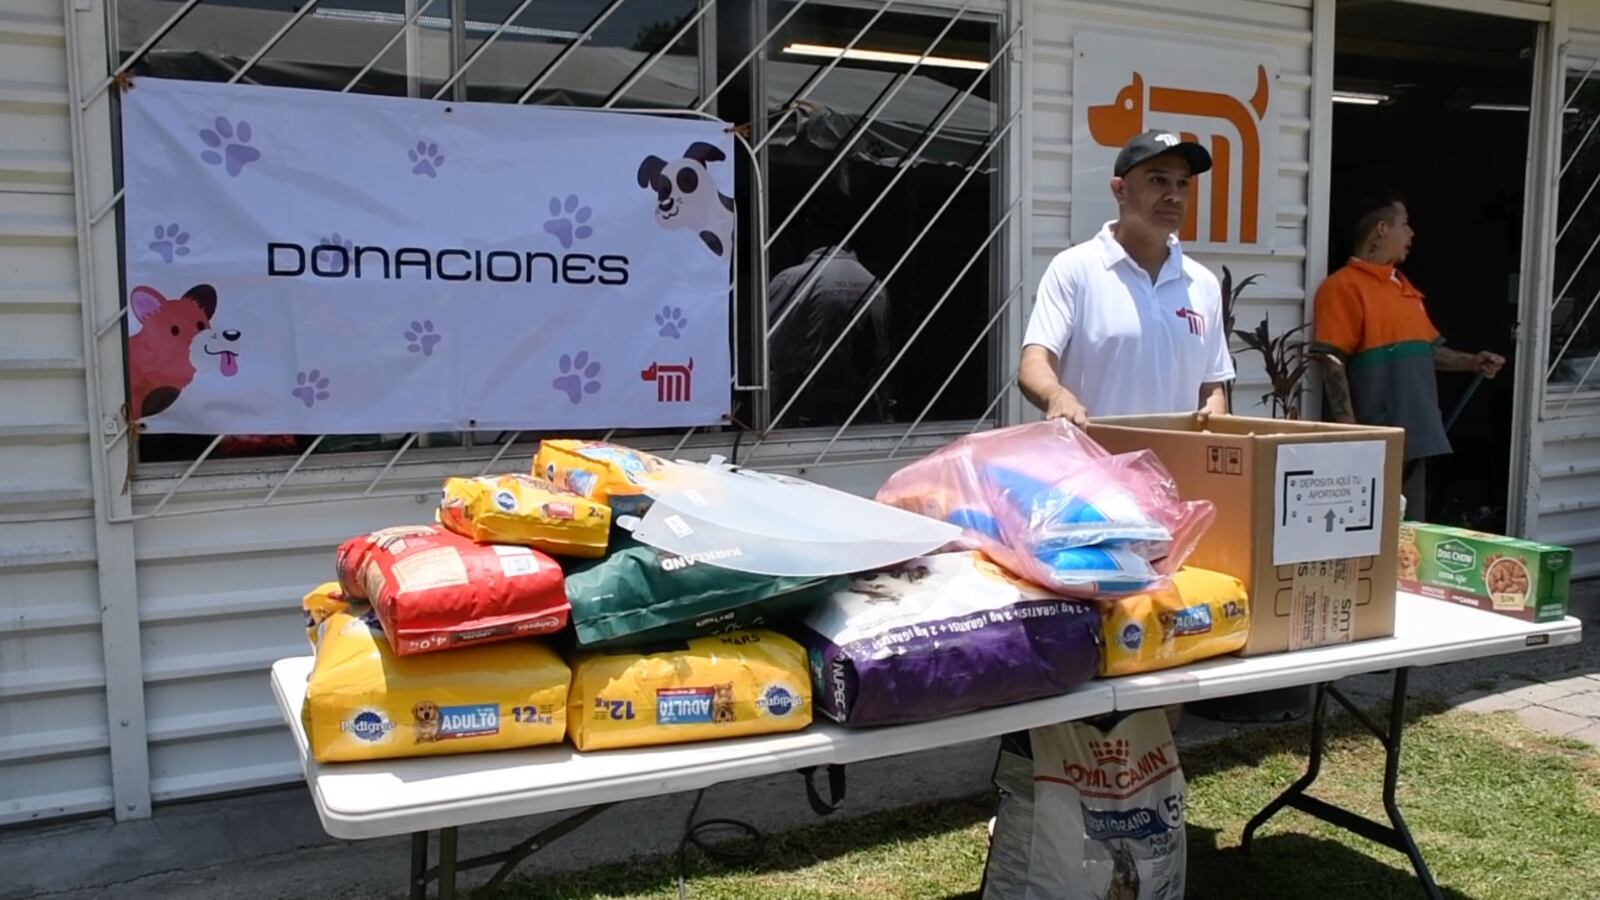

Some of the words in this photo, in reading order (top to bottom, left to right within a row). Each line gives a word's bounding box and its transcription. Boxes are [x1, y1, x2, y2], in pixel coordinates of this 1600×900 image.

[266, 241, 630, 286] DONACIONES
[831, 662, 847, 708] NUPEC
[441, 713, 497, 732] ADULTO
[659, 698, 711, 717] ADULTO
[1115, 746, 1168, 790] CANIN
